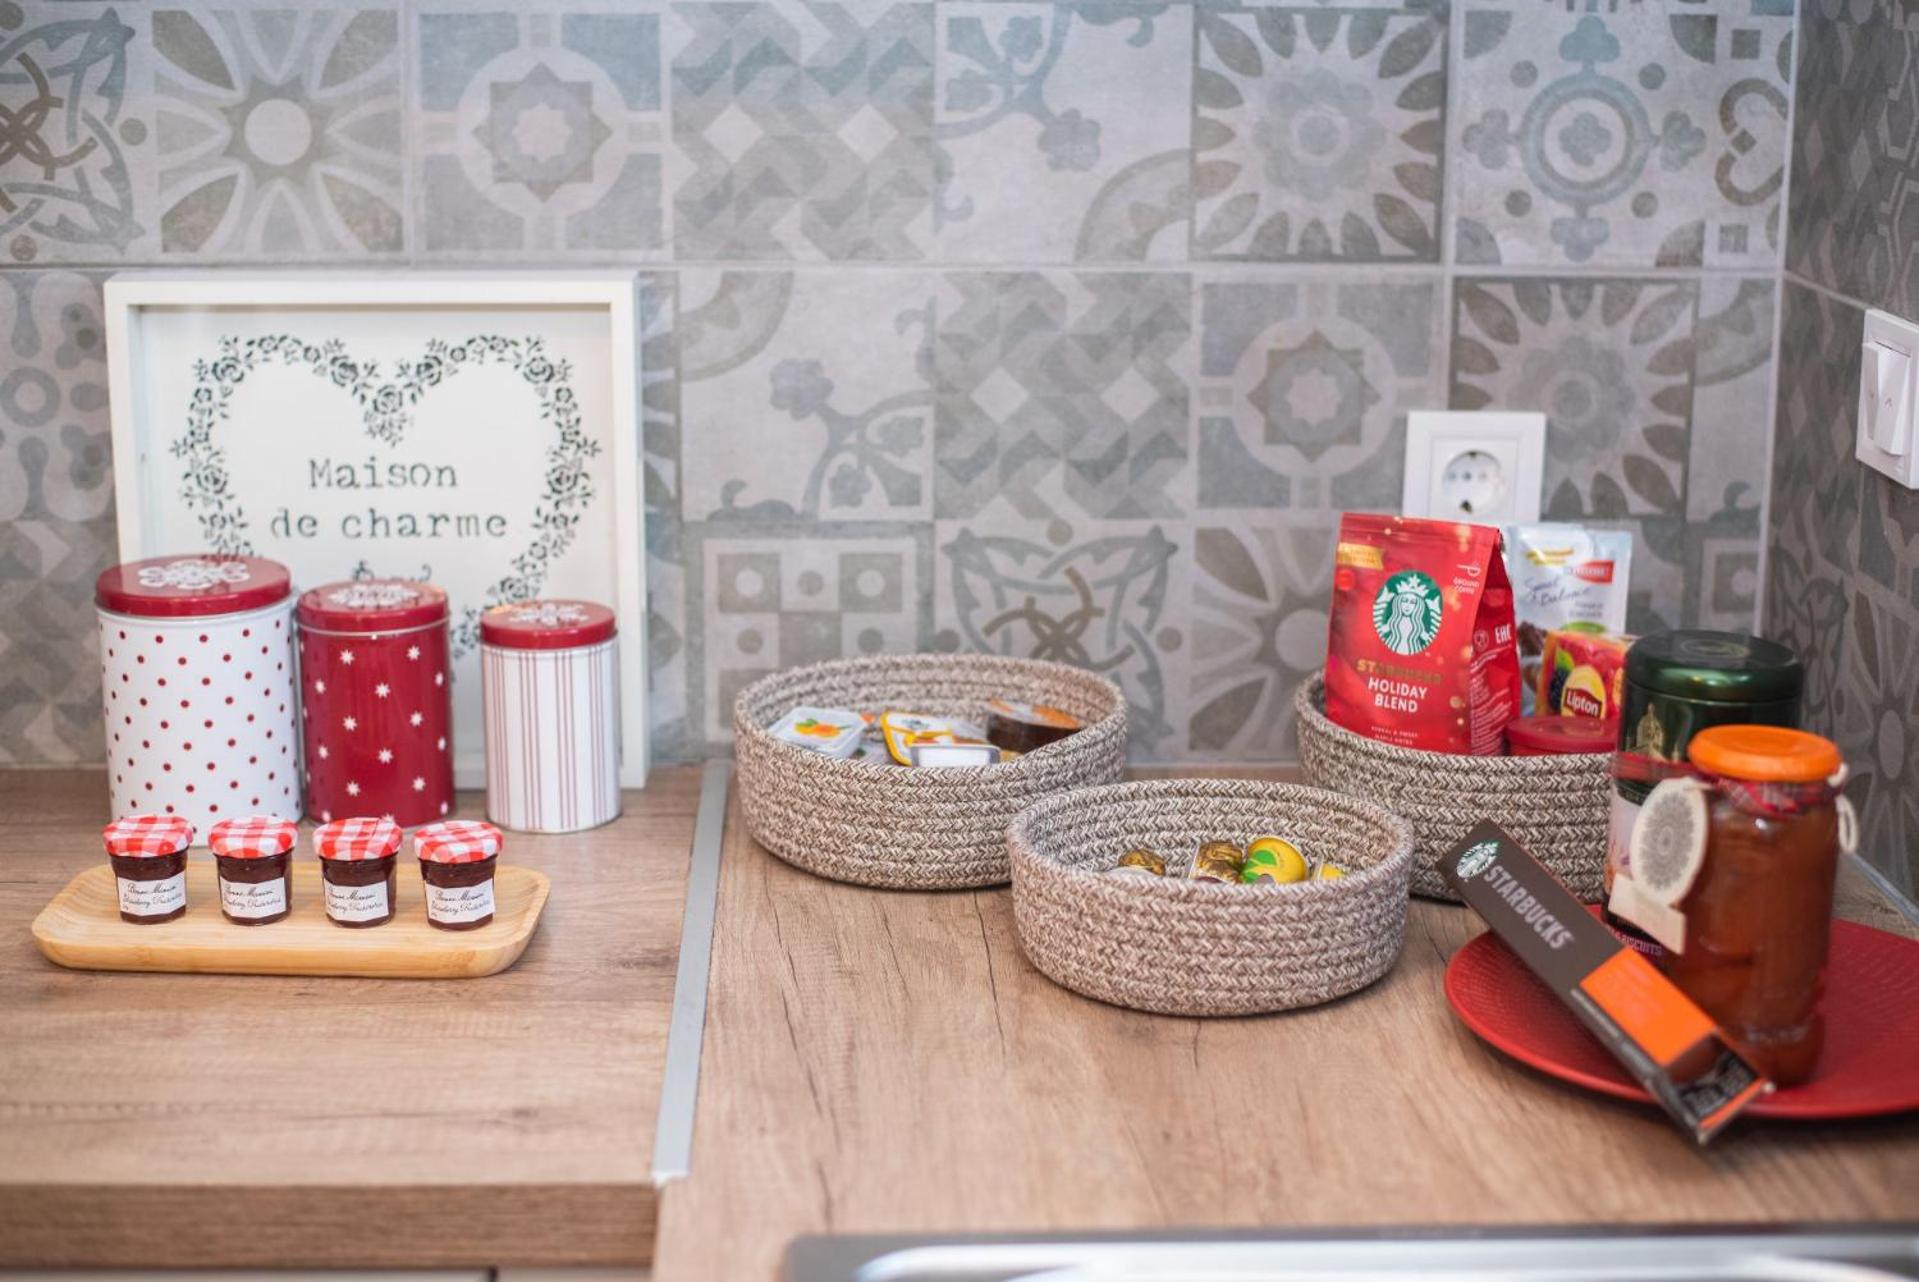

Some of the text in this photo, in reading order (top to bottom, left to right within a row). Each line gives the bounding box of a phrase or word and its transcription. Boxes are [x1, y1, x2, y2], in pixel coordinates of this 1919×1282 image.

[309, 456, 458, 489] Maison
[270, 508, 507, 539] de charme
[1453, 576, 1480, 589] GROUND
[1367, 677, 1428, 700] HOLIDAY
[1374, 693, 1419, 714] BLEND
[1566, 689, 1600, 717] Lipton
[1483, 864, 1575, 950] STARBUCKS
